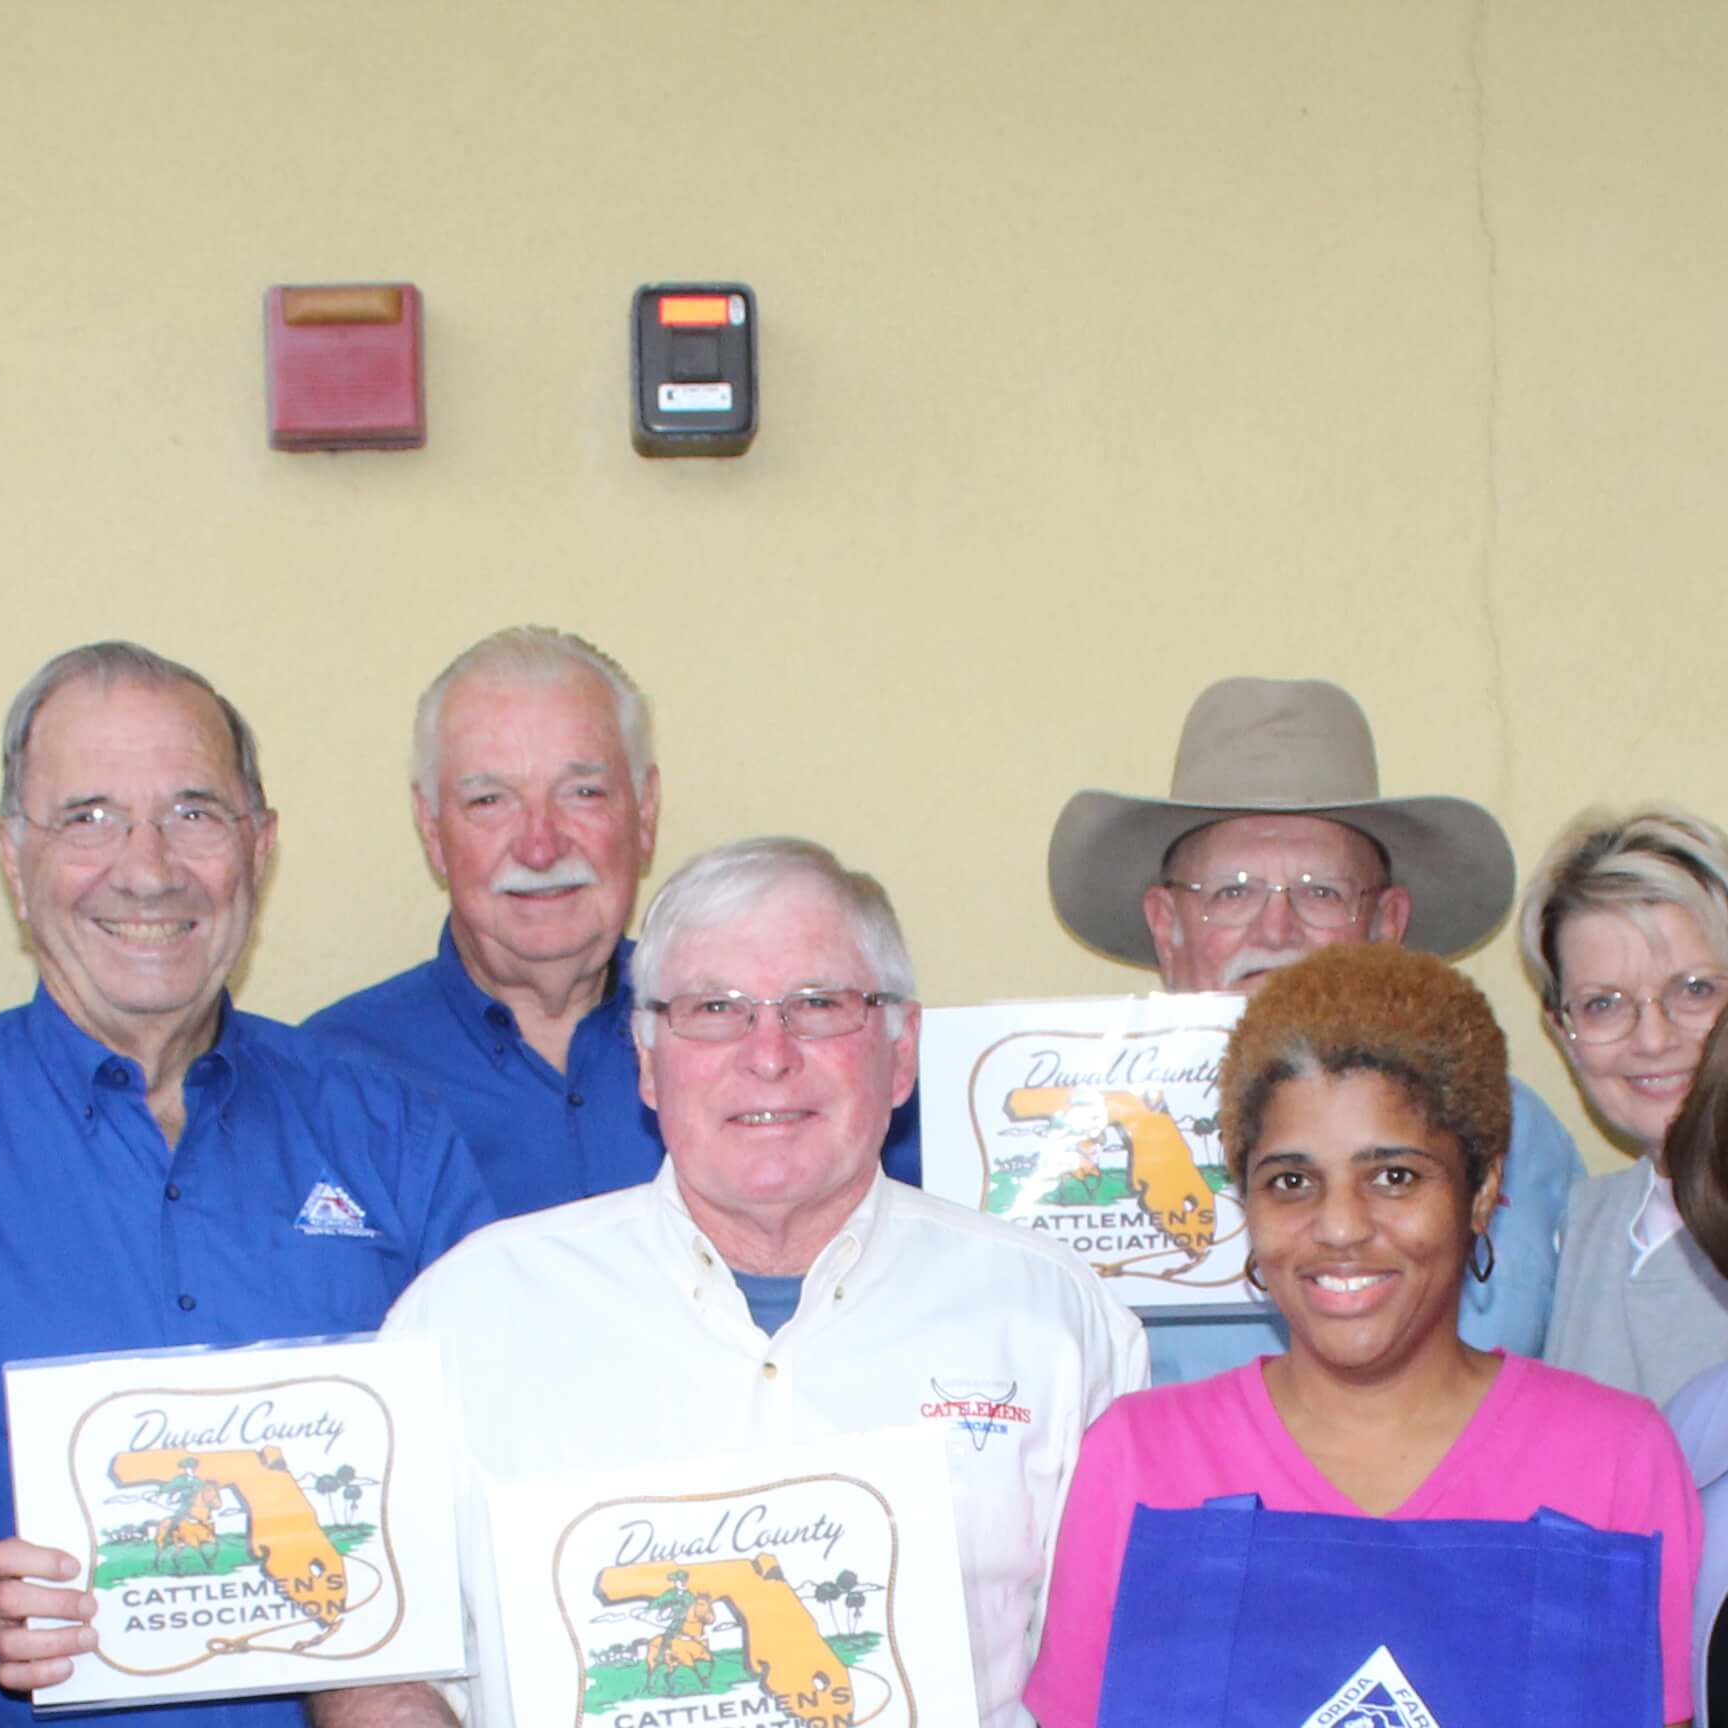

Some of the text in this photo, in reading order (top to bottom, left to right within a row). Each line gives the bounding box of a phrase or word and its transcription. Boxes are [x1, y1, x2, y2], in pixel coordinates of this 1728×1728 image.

[1024, 1046, 1222, 1099] Duval County
[1010, 1205, 1214, 1231] ATTLEMEN'S
[1056, 1227, 1217, 1253] OCIATION
[129, 1400, 345, 1455] Duval County
[615, 1504, 845, 1567] Duval County
[124, 1599, 346, 1633] ASSOCIATION
